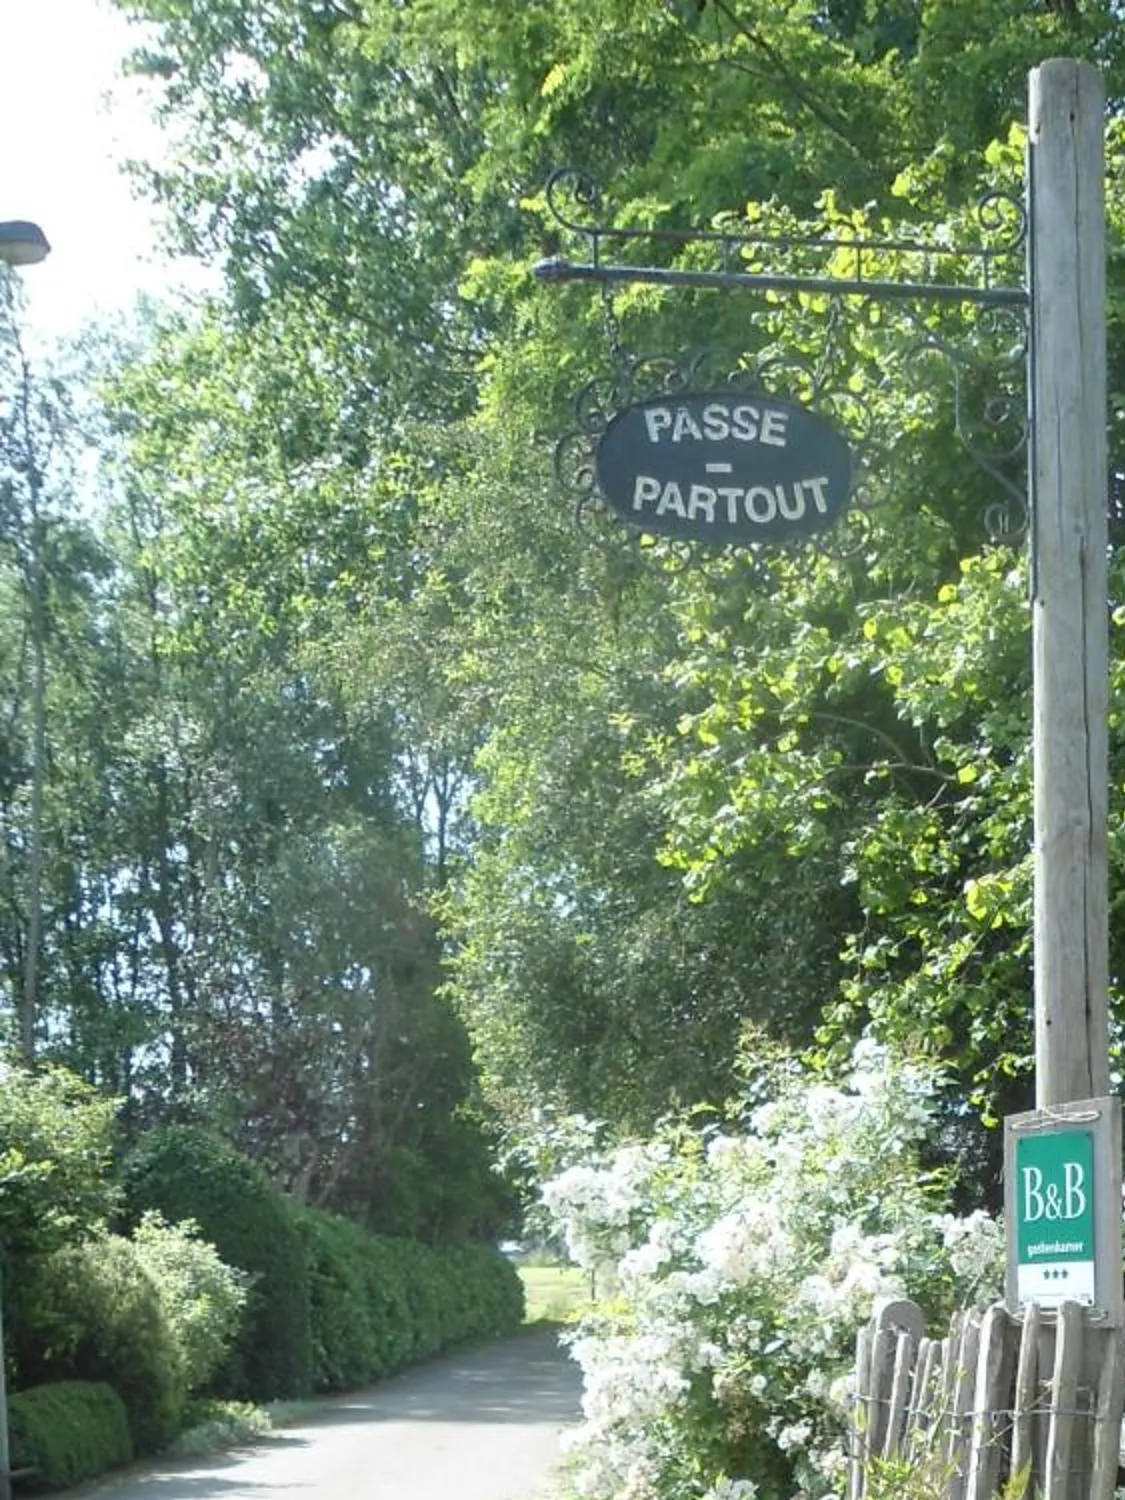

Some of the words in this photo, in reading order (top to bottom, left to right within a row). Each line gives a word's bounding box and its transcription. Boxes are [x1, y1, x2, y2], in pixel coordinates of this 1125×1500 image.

[644, 403, 789, 447] PASSE
[632, 475, 829, 523] PARTOUT
[1022, 1162, 1087, 1222] B&B
